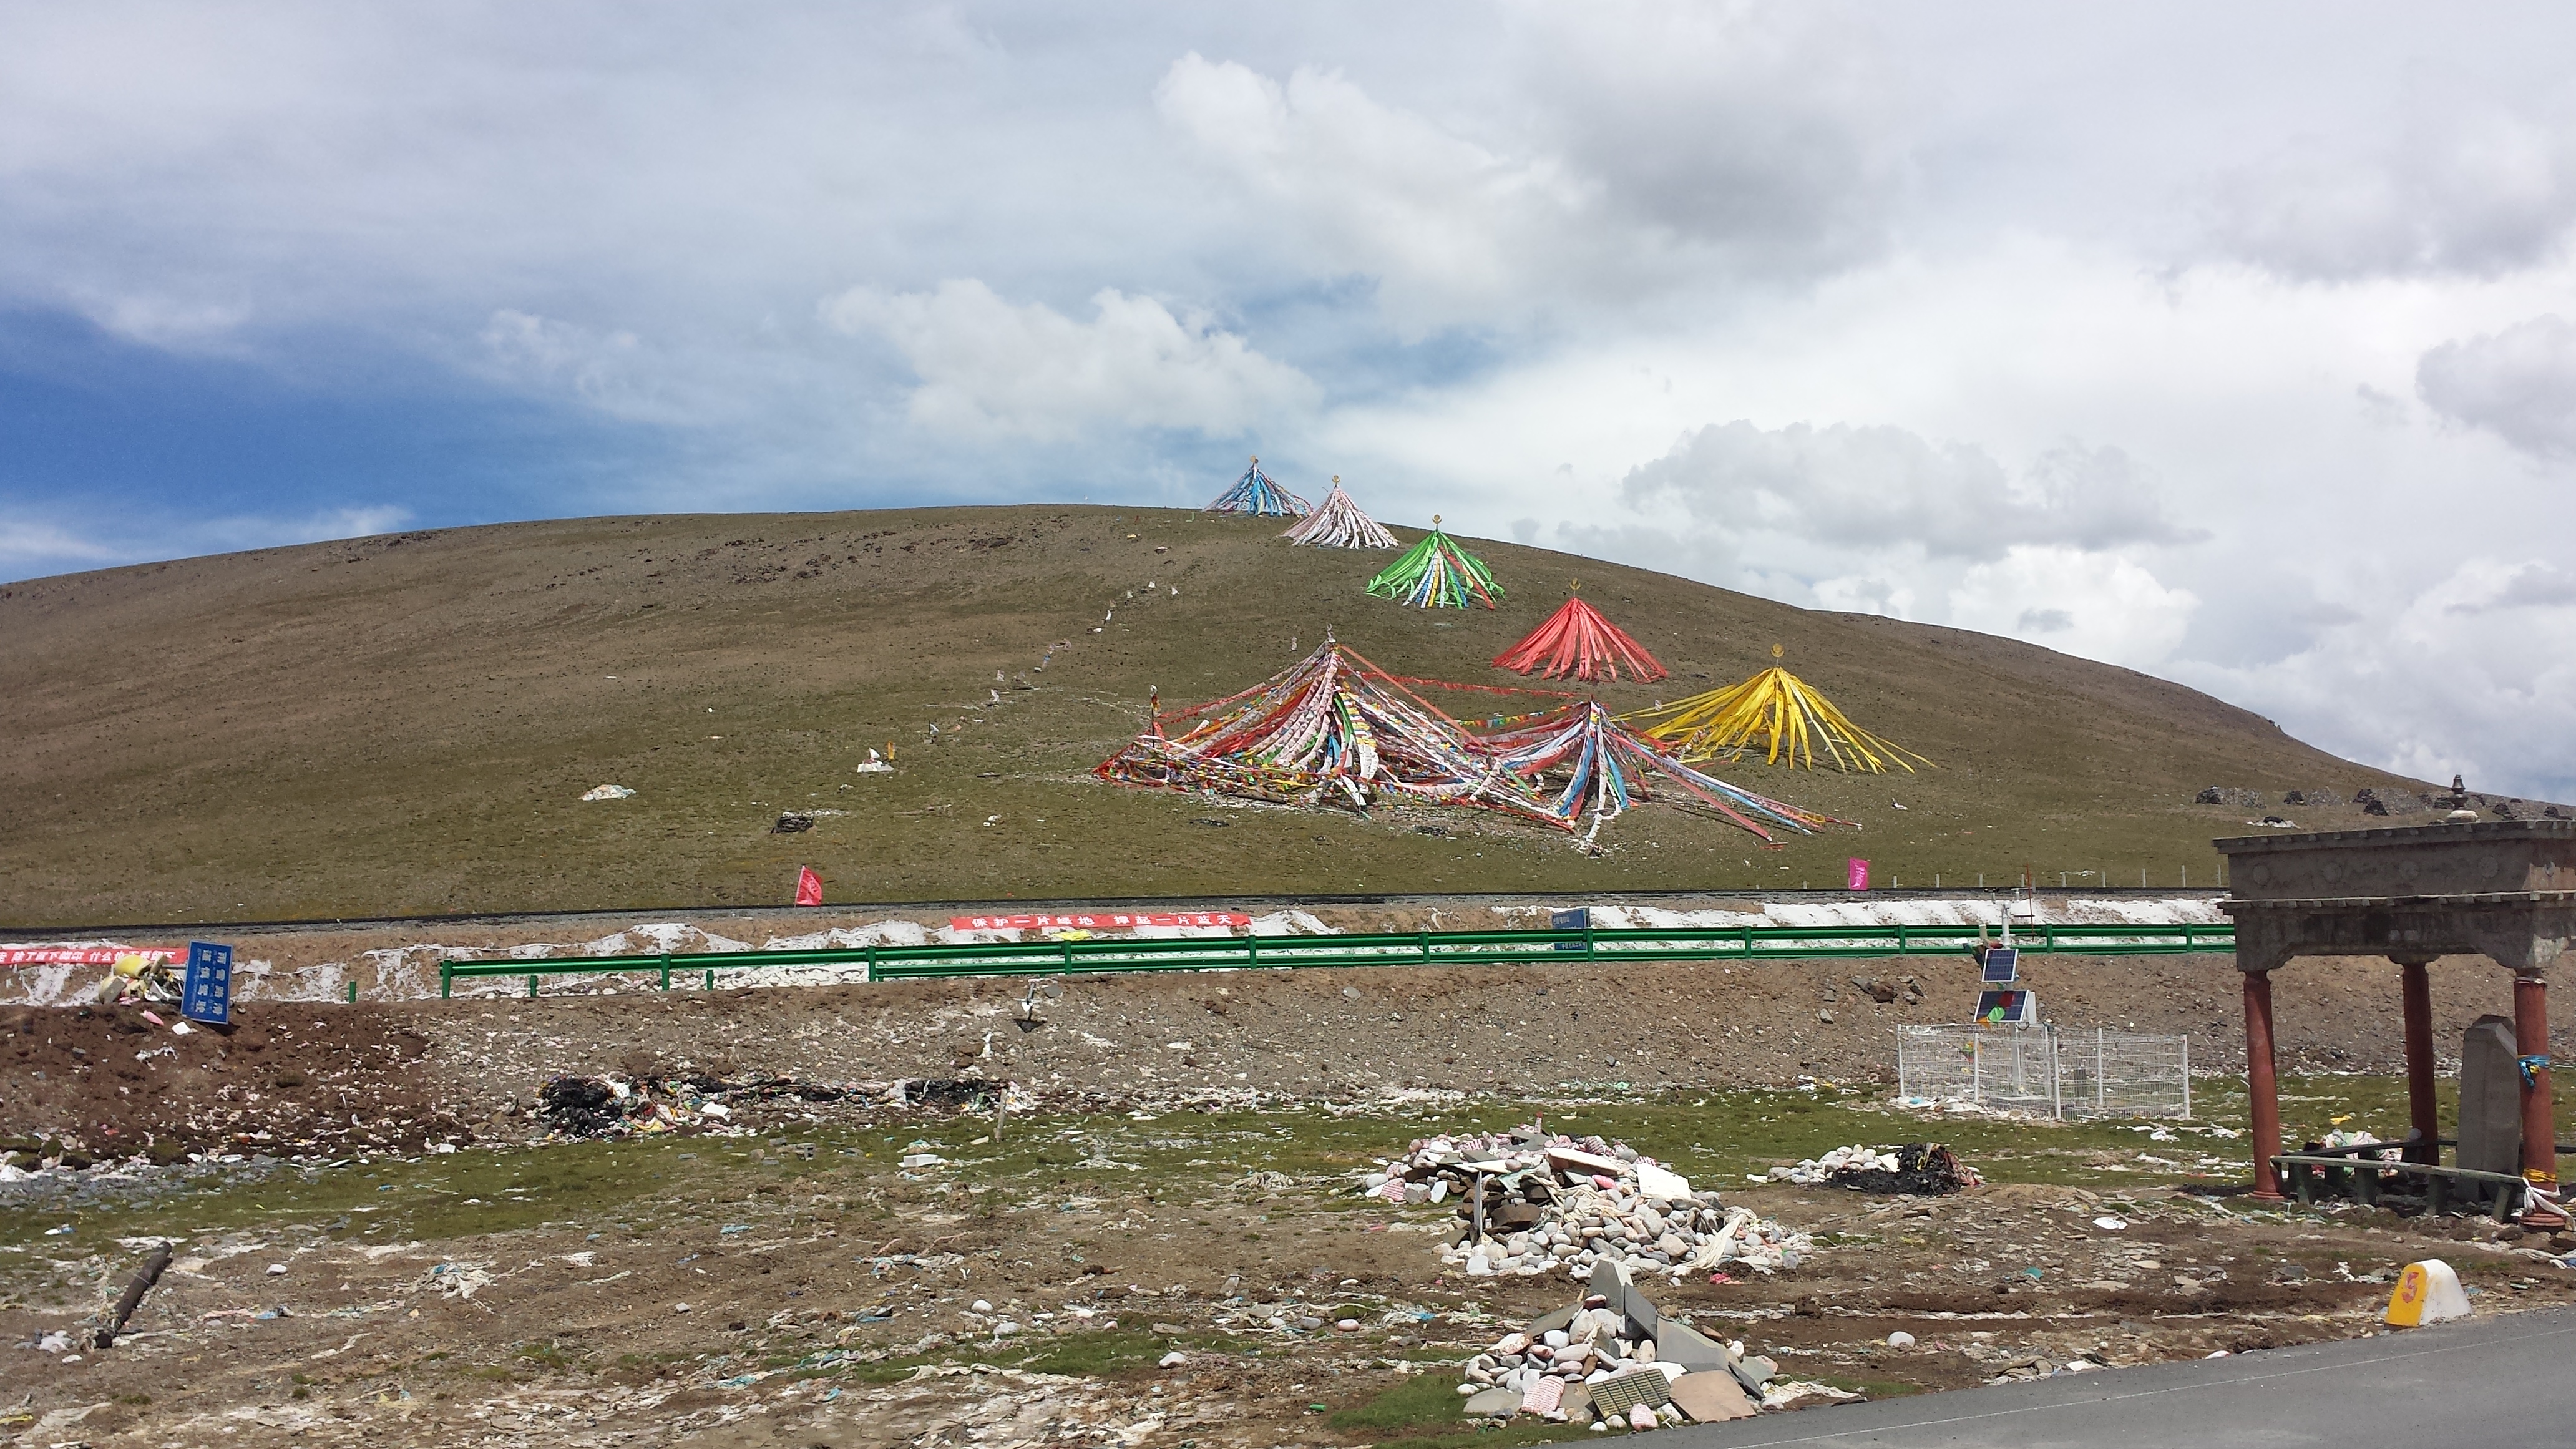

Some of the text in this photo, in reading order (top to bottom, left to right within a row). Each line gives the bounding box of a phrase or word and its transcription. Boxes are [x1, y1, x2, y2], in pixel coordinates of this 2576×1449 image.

[972, 915, 1232, 927] 保护一片绿地 撑起一片蓝天
[11, 950, 85, 962] 除了留下脚印
[2401, 1272, 2419, 1304] 5
